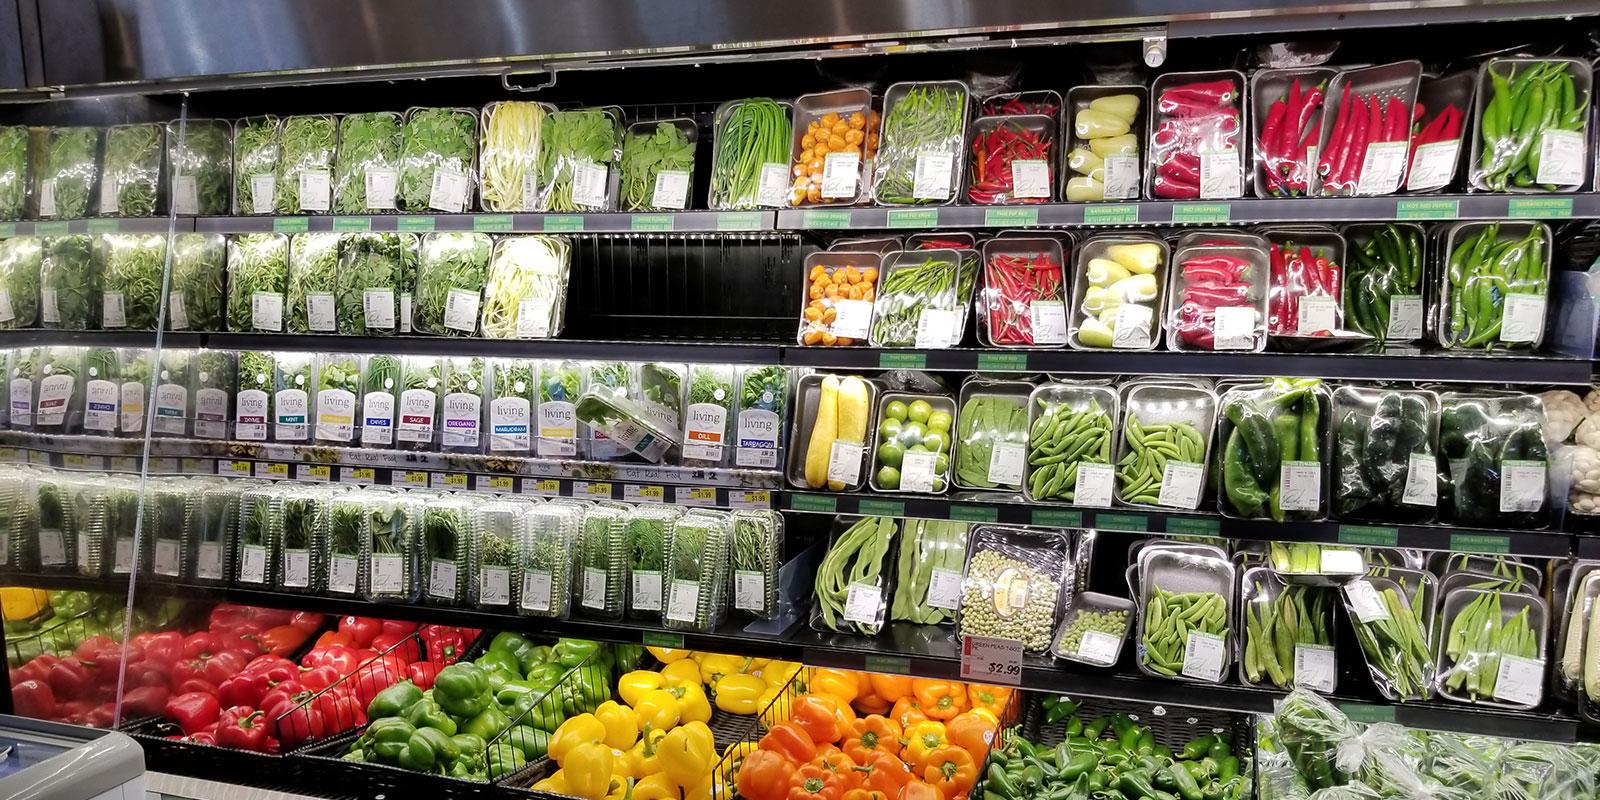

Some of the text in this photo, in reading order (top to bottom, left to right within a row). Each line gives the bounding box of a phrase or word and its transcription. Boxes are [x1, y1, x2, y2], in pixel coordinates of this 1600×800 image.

[241, 397, 263, 409] living
[280, 397, 302, 409] living
[324, 395, 350, 408] living
[368, 399, 390, 411] living
[406, 396, 430, 409] living
[449, 400, 474, 411] living
[497, 405, 524, 417] living
[544, 408, 571, 420] living
[646, 406, 673, 423] living
[692, 410, 720, 424] living
[744, 417, 772, 431] living
[626, 468, 640, 477] Eat
[988, 662, 1020, 675] $2.99
